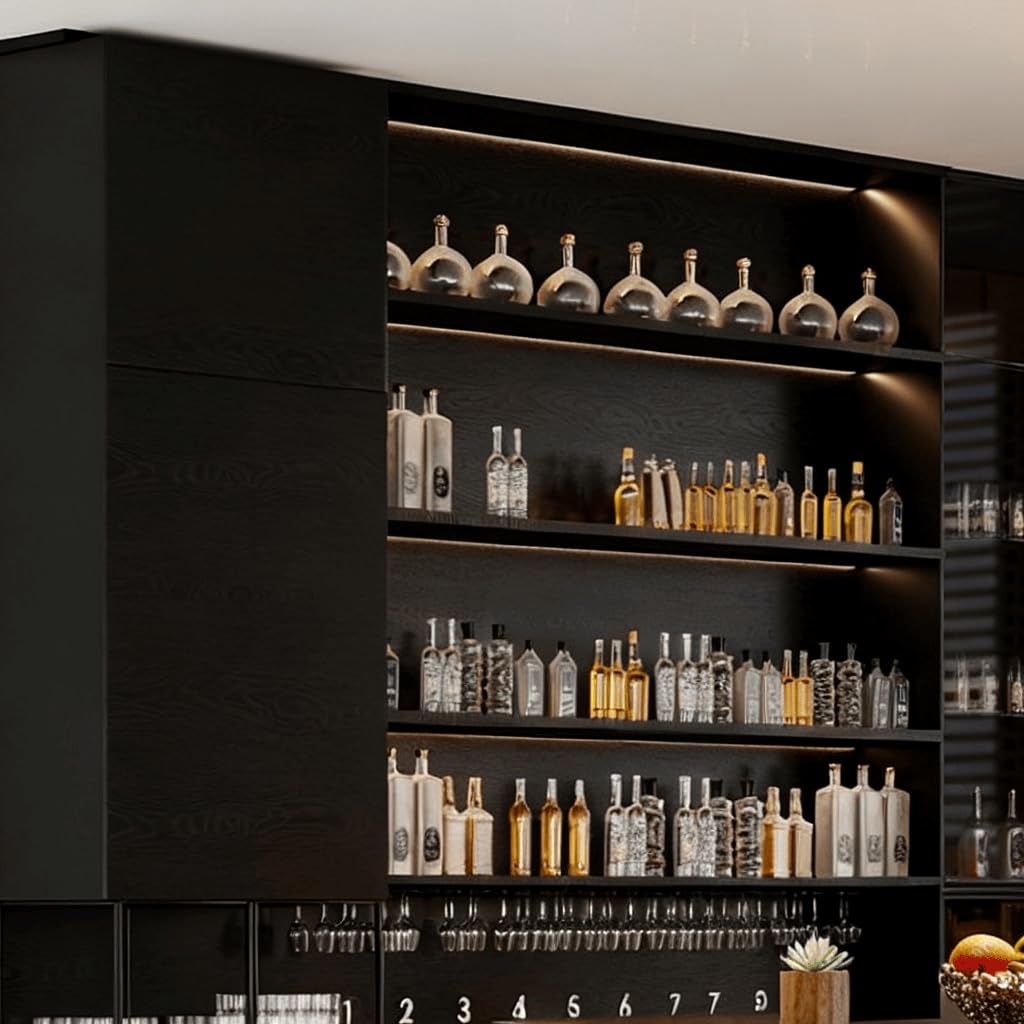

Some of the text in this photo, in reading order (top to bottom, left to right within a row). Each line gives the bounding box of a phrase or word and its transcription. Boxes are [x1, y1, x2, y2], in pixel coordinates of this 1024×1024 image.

[398, 997, 414, 1024] 2
[456, 996, 471, 1024] 3
[619, 992, 632, 1017] 6
[669, 992, 681, 1016] 7
[708, 991, 721, 1015] 7
